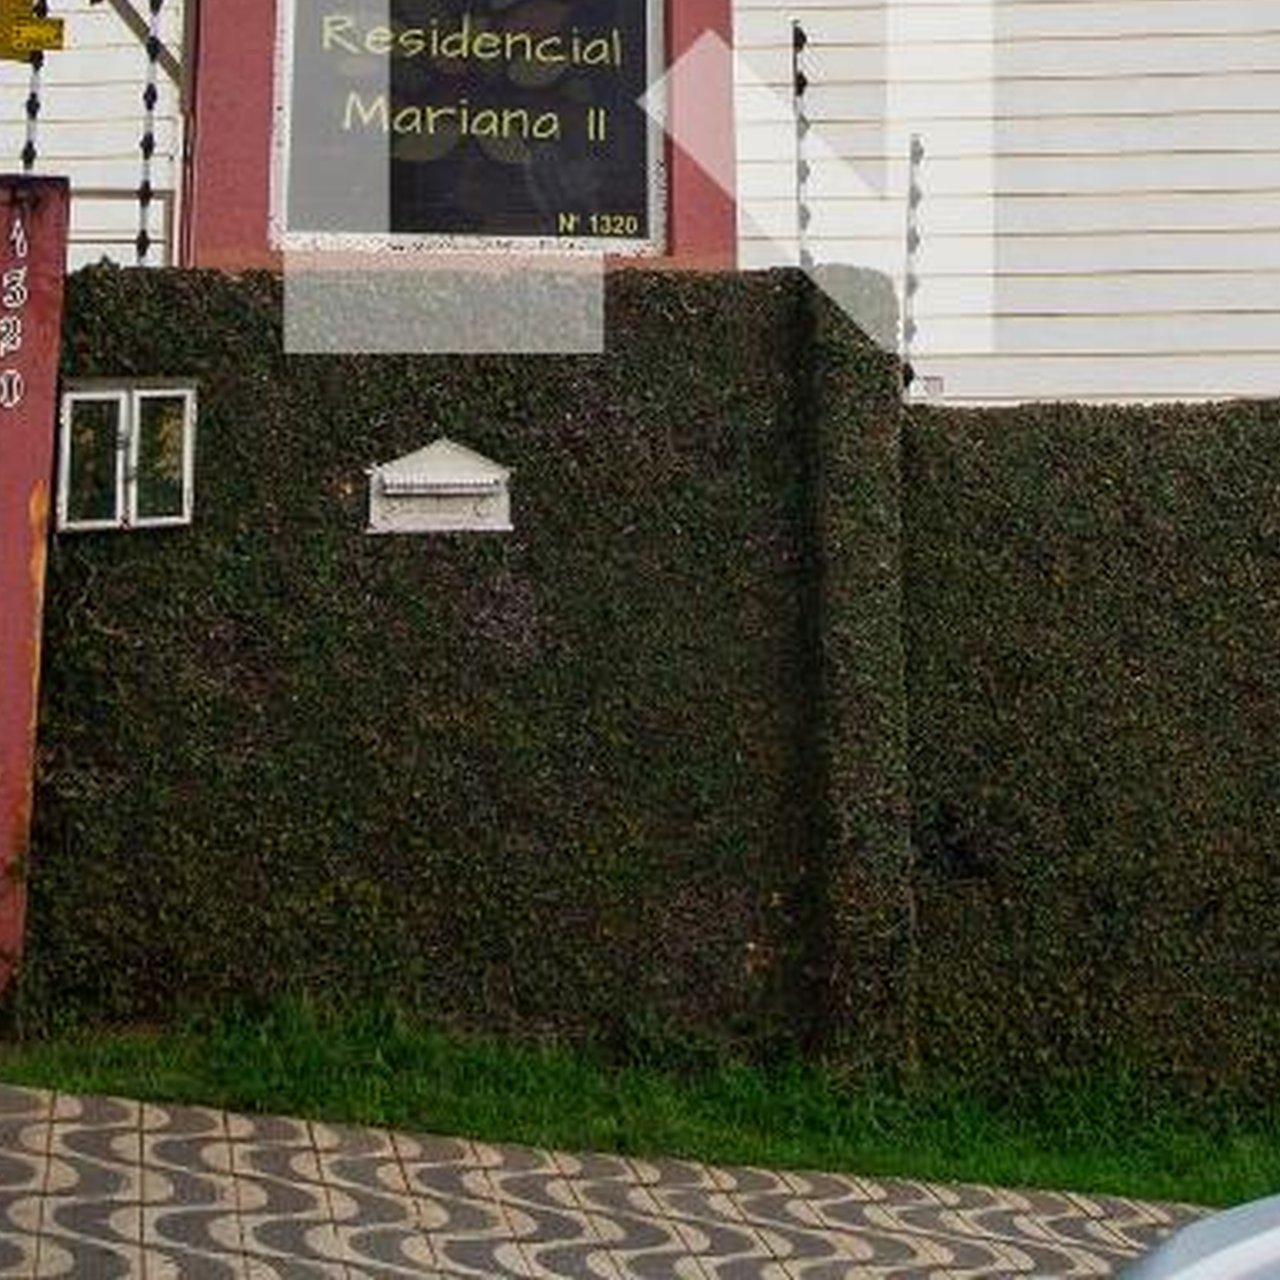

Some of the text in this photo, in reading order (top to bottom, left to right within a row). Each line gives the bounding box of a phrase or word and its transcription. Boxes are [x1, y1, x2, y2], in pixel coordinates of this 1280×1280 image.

[322, 13, 622, 67] Residencial
[342, 92, 607, 141] Mariana II
[589, 214, 639, 235] 1320
